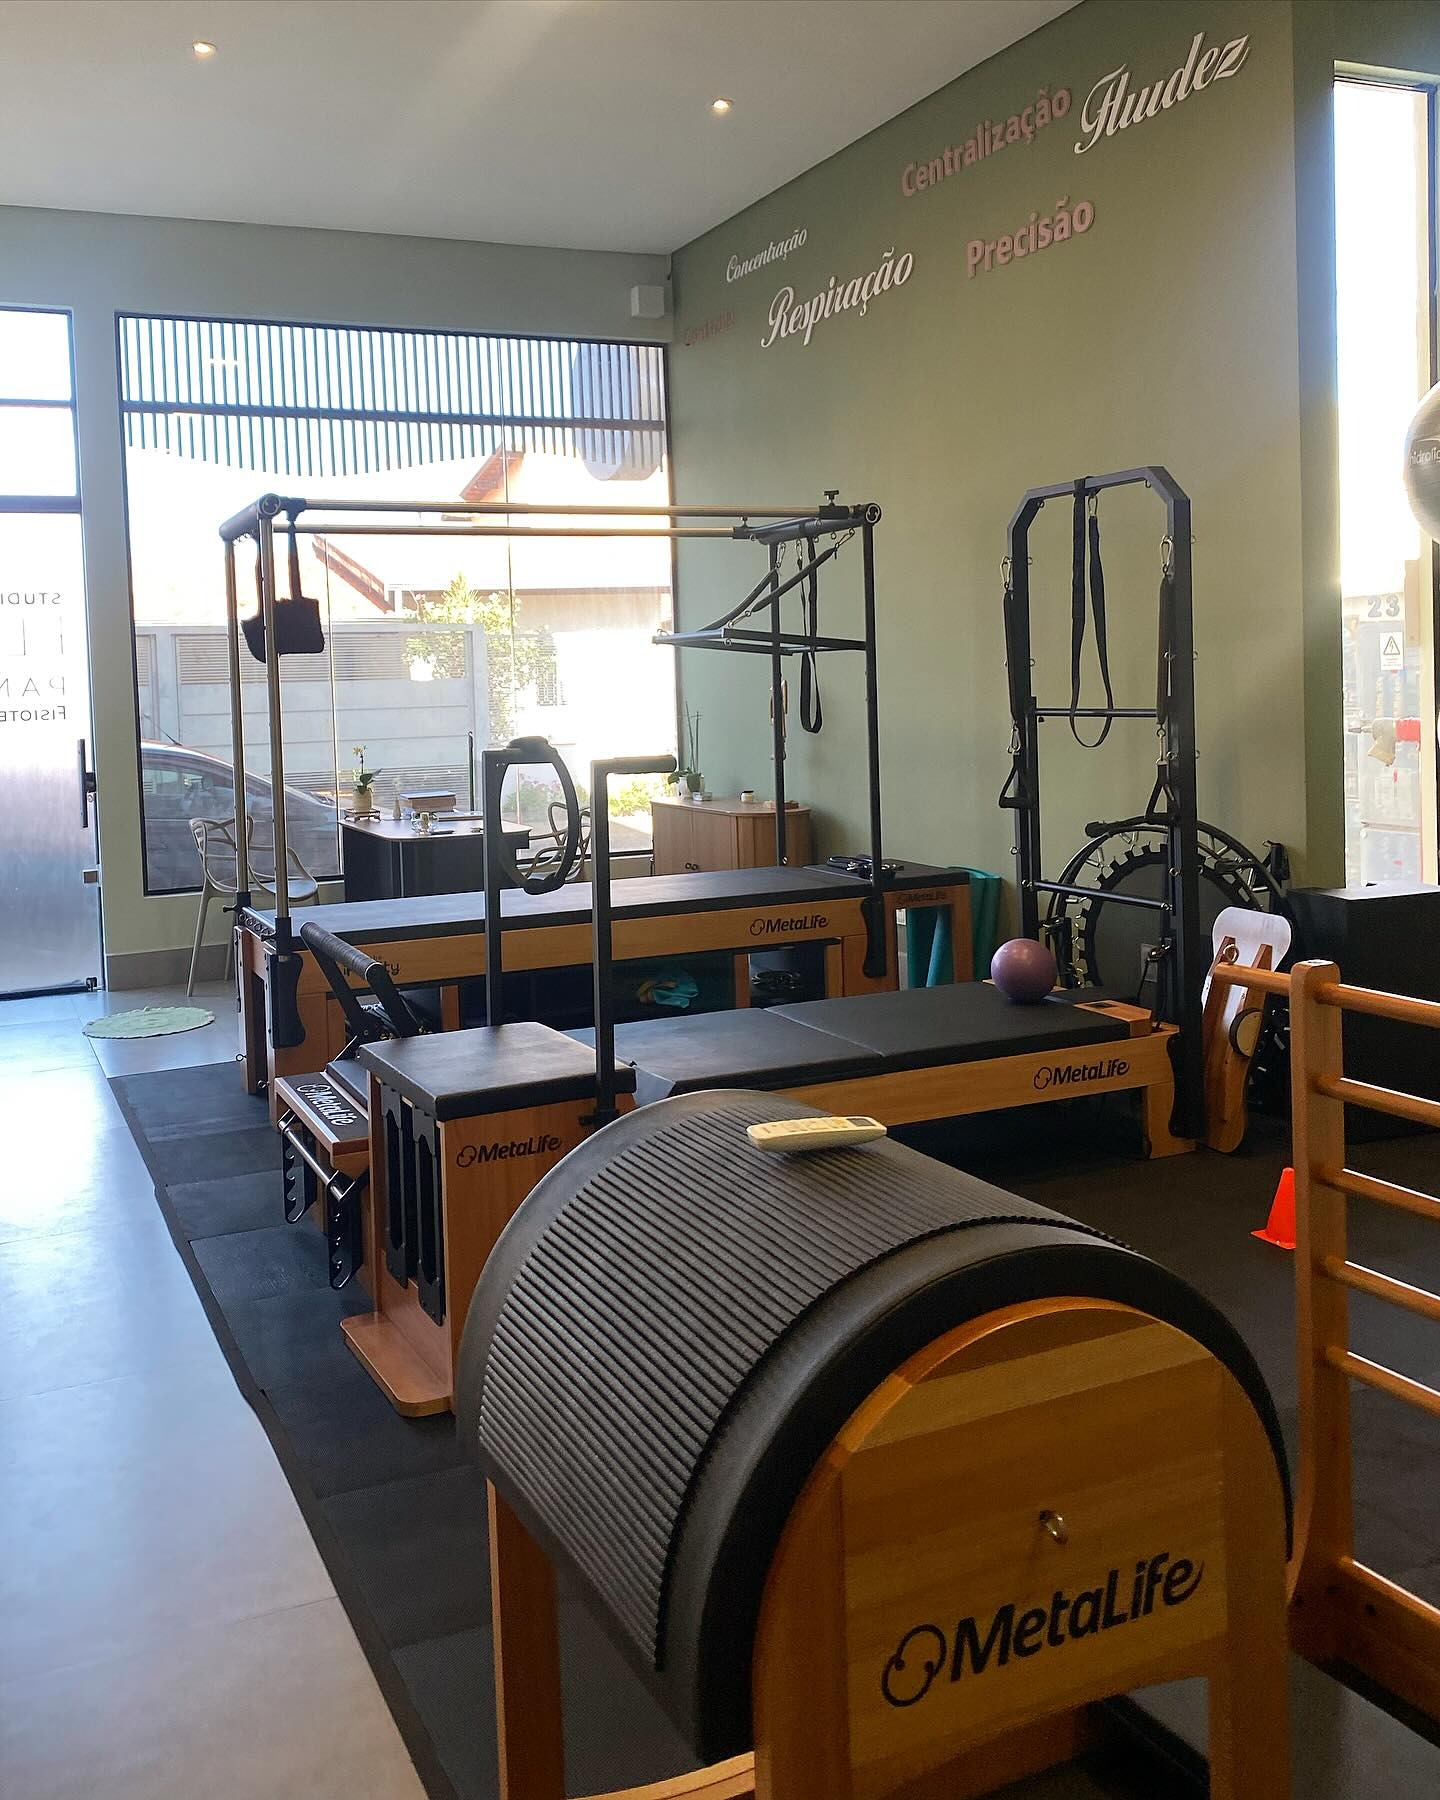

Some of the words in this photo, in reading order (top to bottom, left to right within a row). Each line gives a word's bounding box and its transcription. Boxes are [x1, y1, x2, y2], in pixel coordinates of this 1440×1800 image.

[902, 84, 1073, 197] Centralização
[725, 228, 808, 283] Concentração
[966, 193, 1096, 279] Precisão
[760, 245, 914, 348] Respiração
[1367, 594, 1400, 618] 23
[766, 914, 829, 933] MetaLife
[1053, 1058, 1130, 1085] MetaLife
[477, 1134, 563, 1163] MetaLife
[950, 1551, 1205, 1683] MetaLife
